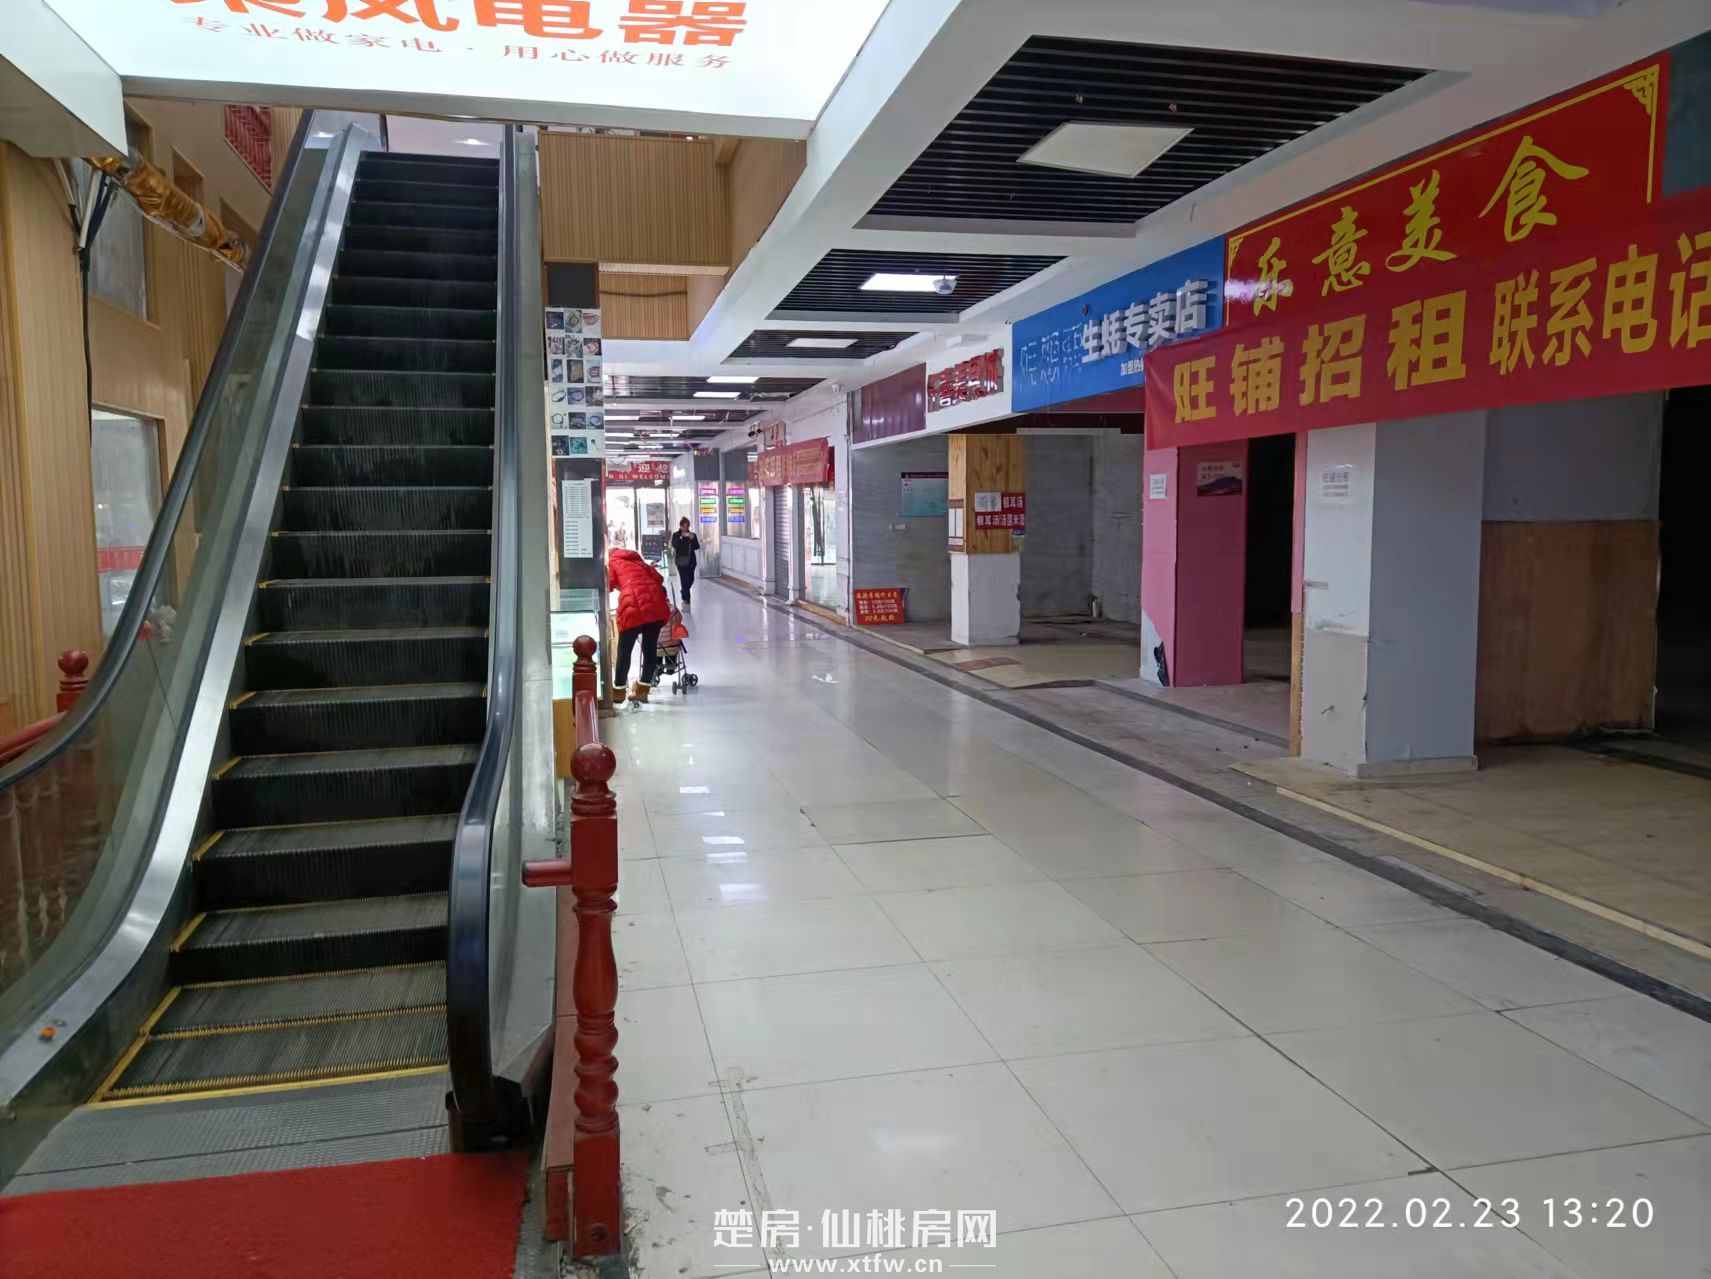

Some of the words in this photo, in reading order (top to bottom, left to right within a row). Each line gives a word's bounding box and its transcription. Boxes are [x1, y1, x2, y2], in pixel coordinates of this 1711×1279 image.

[1252, 135, 1591, 317] 乐意美食
[1081, 279, 1210, 363] 生蚝专卖店
